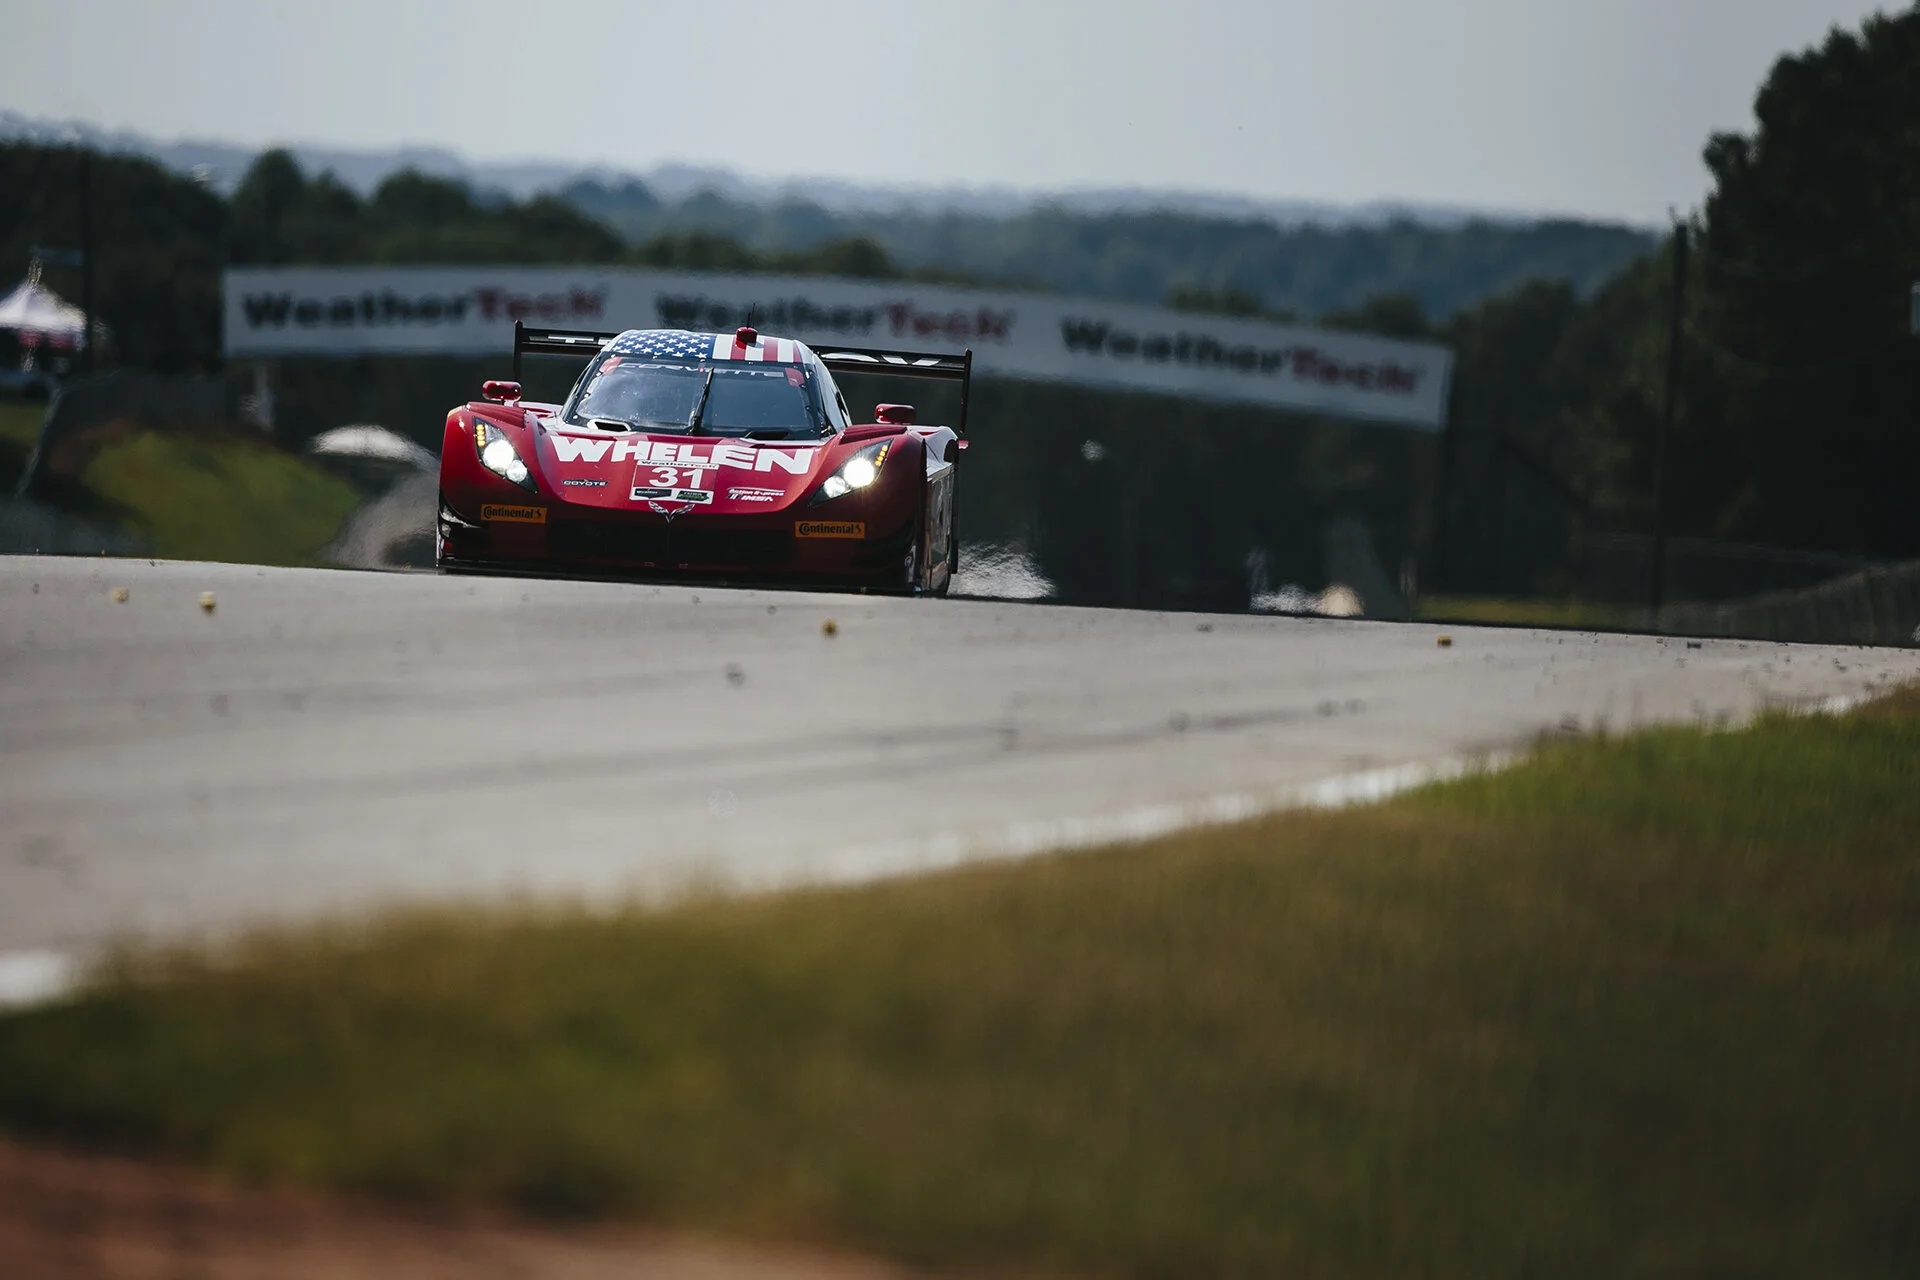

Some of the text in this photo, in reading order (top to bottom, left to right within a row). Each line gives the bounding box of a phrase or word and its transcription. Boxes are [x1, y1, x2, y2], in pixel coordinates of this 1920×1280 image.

[243, 285, 605, 329] WeatherTech
[1061, 307, 1416, 397] WeatherTech
[550, 435, 814, 475] WHELEN
[649, 467, 703, 489] 31
[484, 506, 534, 519] Continental
[799, 523, 854, 535] Continental
